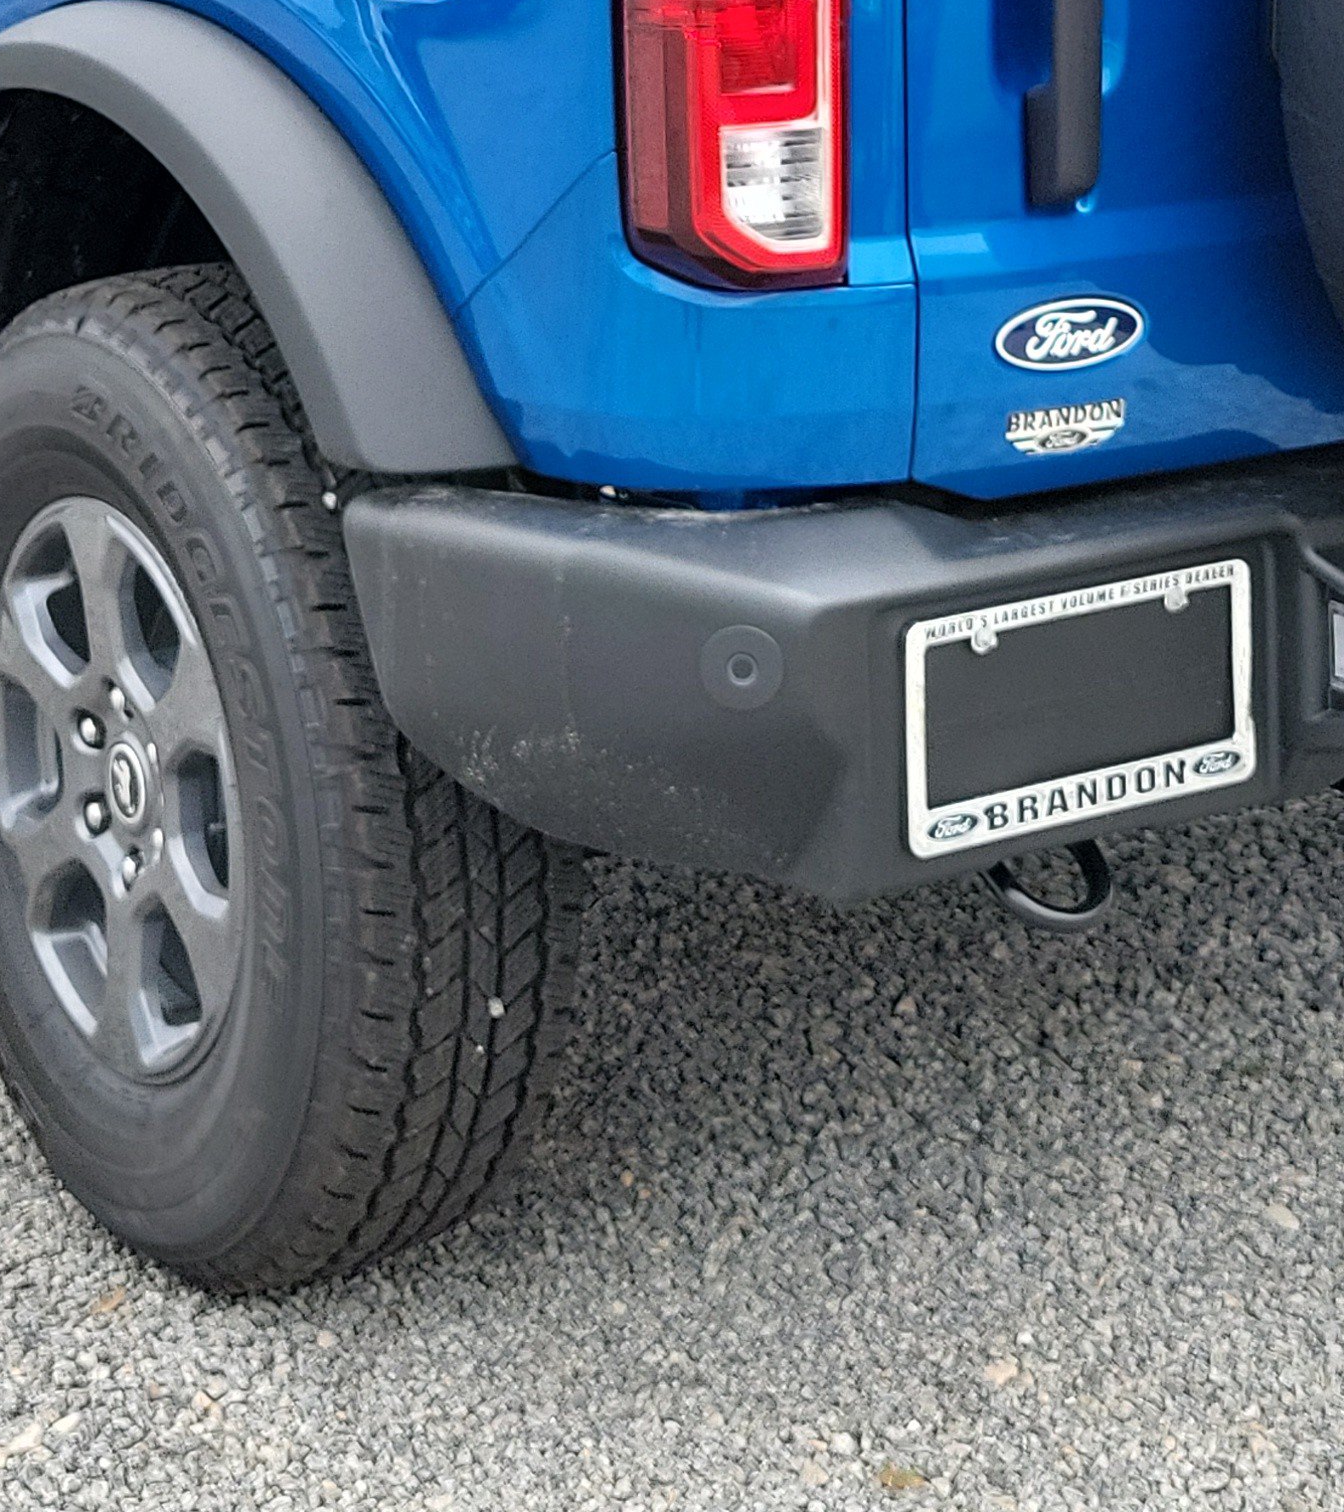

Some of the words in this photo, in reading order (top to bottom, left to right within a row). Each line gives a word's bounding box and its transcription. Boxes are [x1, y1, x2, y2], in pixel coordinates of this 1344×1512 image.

[1025, 309, 1119, 361] Ford
[1007, 397, 1123, 433] BRANDON
[924, 614, 988, 639] WORLDS
[994, 599, 1055, 624] LARGEST
[1060, 589, 1115, 611] VOLUME
[1185, 564, 1235, 584] DEALER
[933, 815, 973, 839] Ford
[982, 758, 1187, 831] BRANDON
[1198, 751, 1237, 775] Ford
